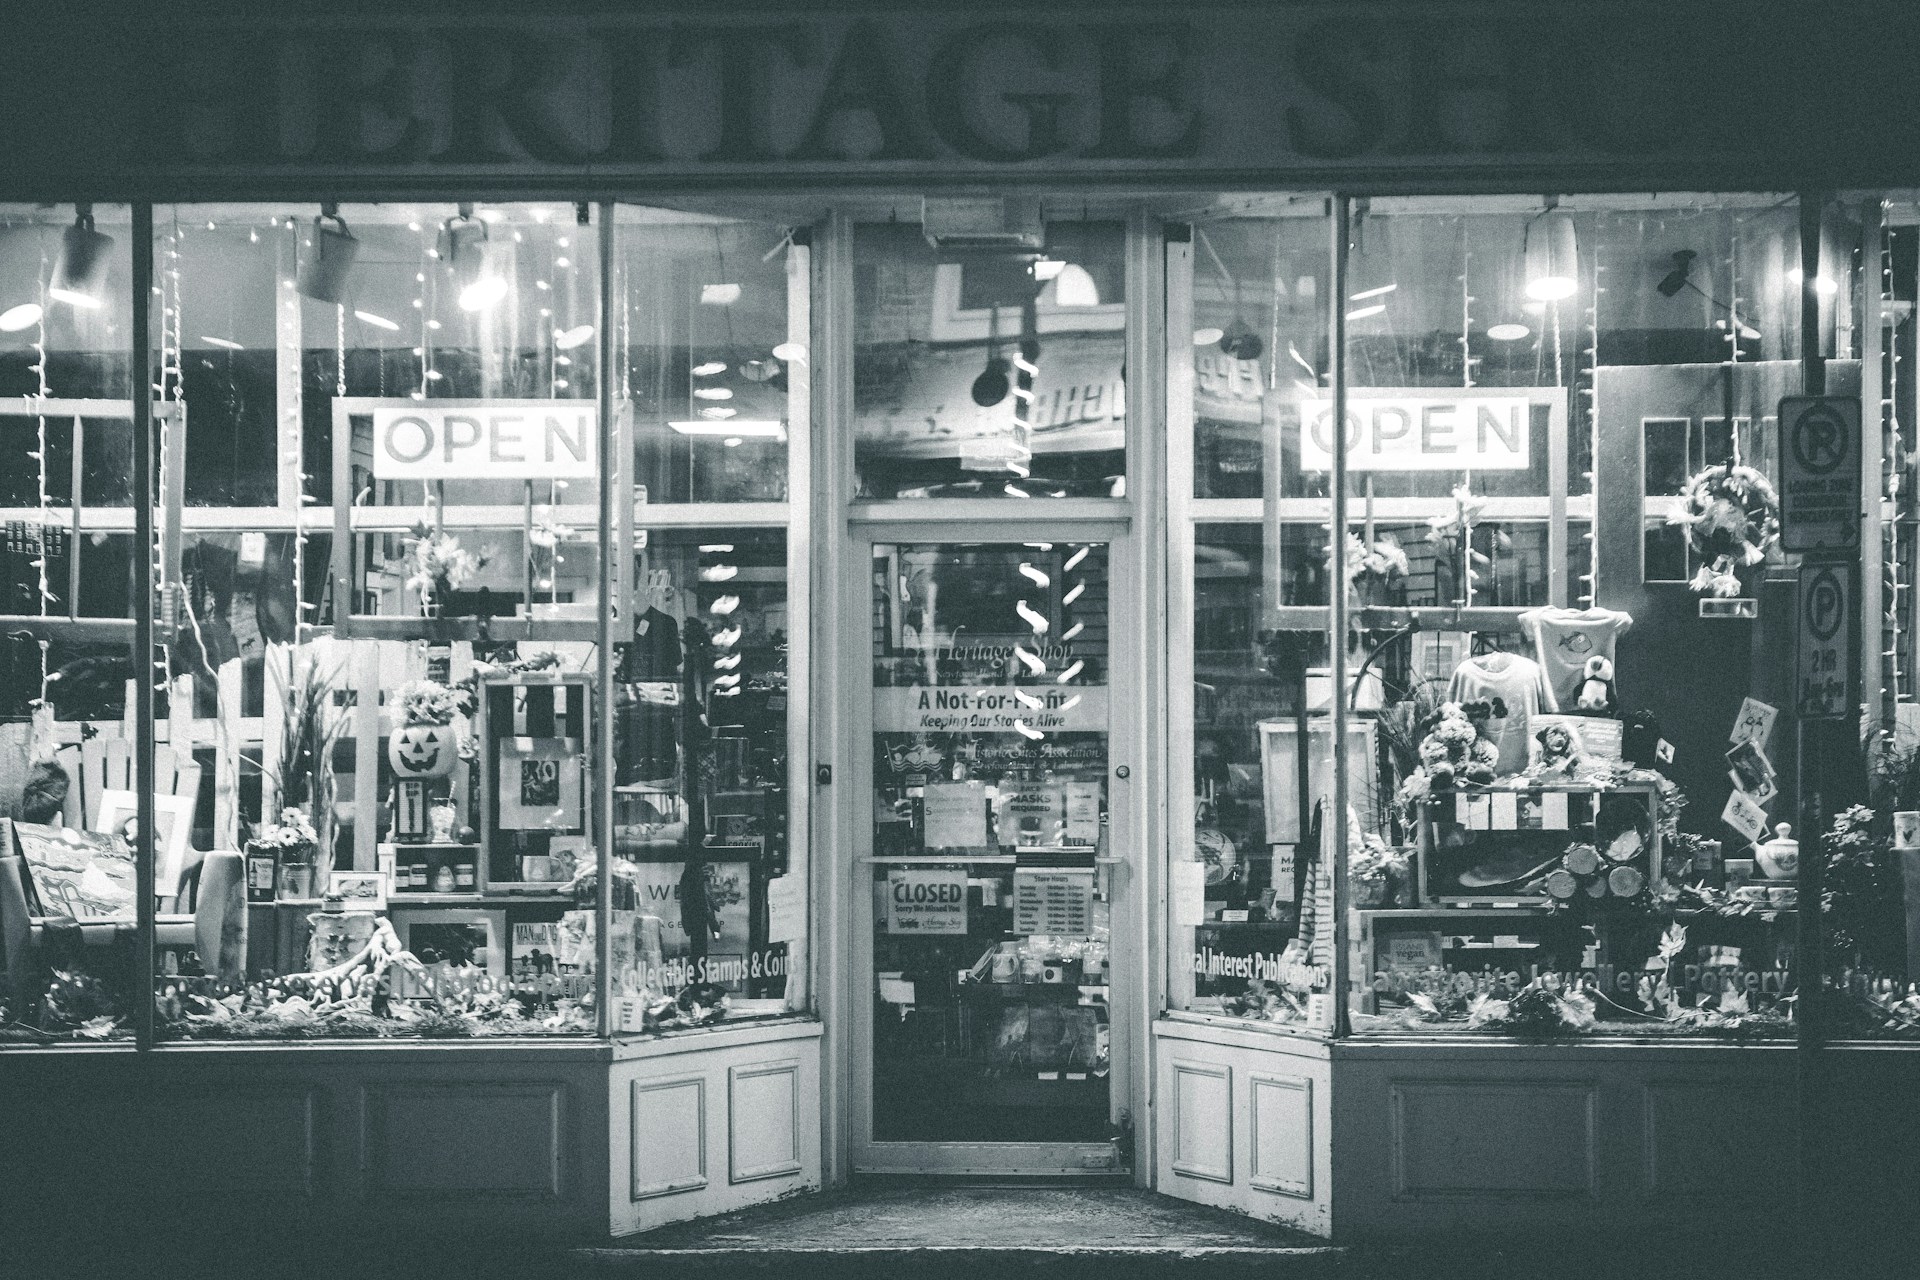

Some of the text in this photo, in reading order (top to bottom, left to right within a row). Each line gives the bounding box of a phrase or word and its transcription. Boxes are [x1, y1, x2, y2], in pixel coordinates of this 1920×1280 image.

[122, 20, 1204, 164] HERITAGE
[384, 415, 588, 463] OPEN
[1310, 404, 1521, 455] OPEN
[1031, 632, 1074, 668] Shop
[1811, 648, 1837, 674] 2 HR
[918, 691, 931, 710] A
[920, 714, 967, 731] Keeping
[970, 714, 991, 728] Our
[1035, 713, 1066, 728] Alive
[1010, 794, 1052, 804] MASKS
[1010, 805, 1051, 813] REQUIRED
[893, 882, 962, 903] CLOSED
[895, 904, 913, 915] Sorry
[1207, 947, 1253, 979] Interest
[1395, 950, 1426, 961] vegan
[619, 956, 696, 991] Collectible
[696, 956, 749, 987] Stamps
[749, 950, 763, 978] &
[1683, 963, 1790, 999] Pottery
